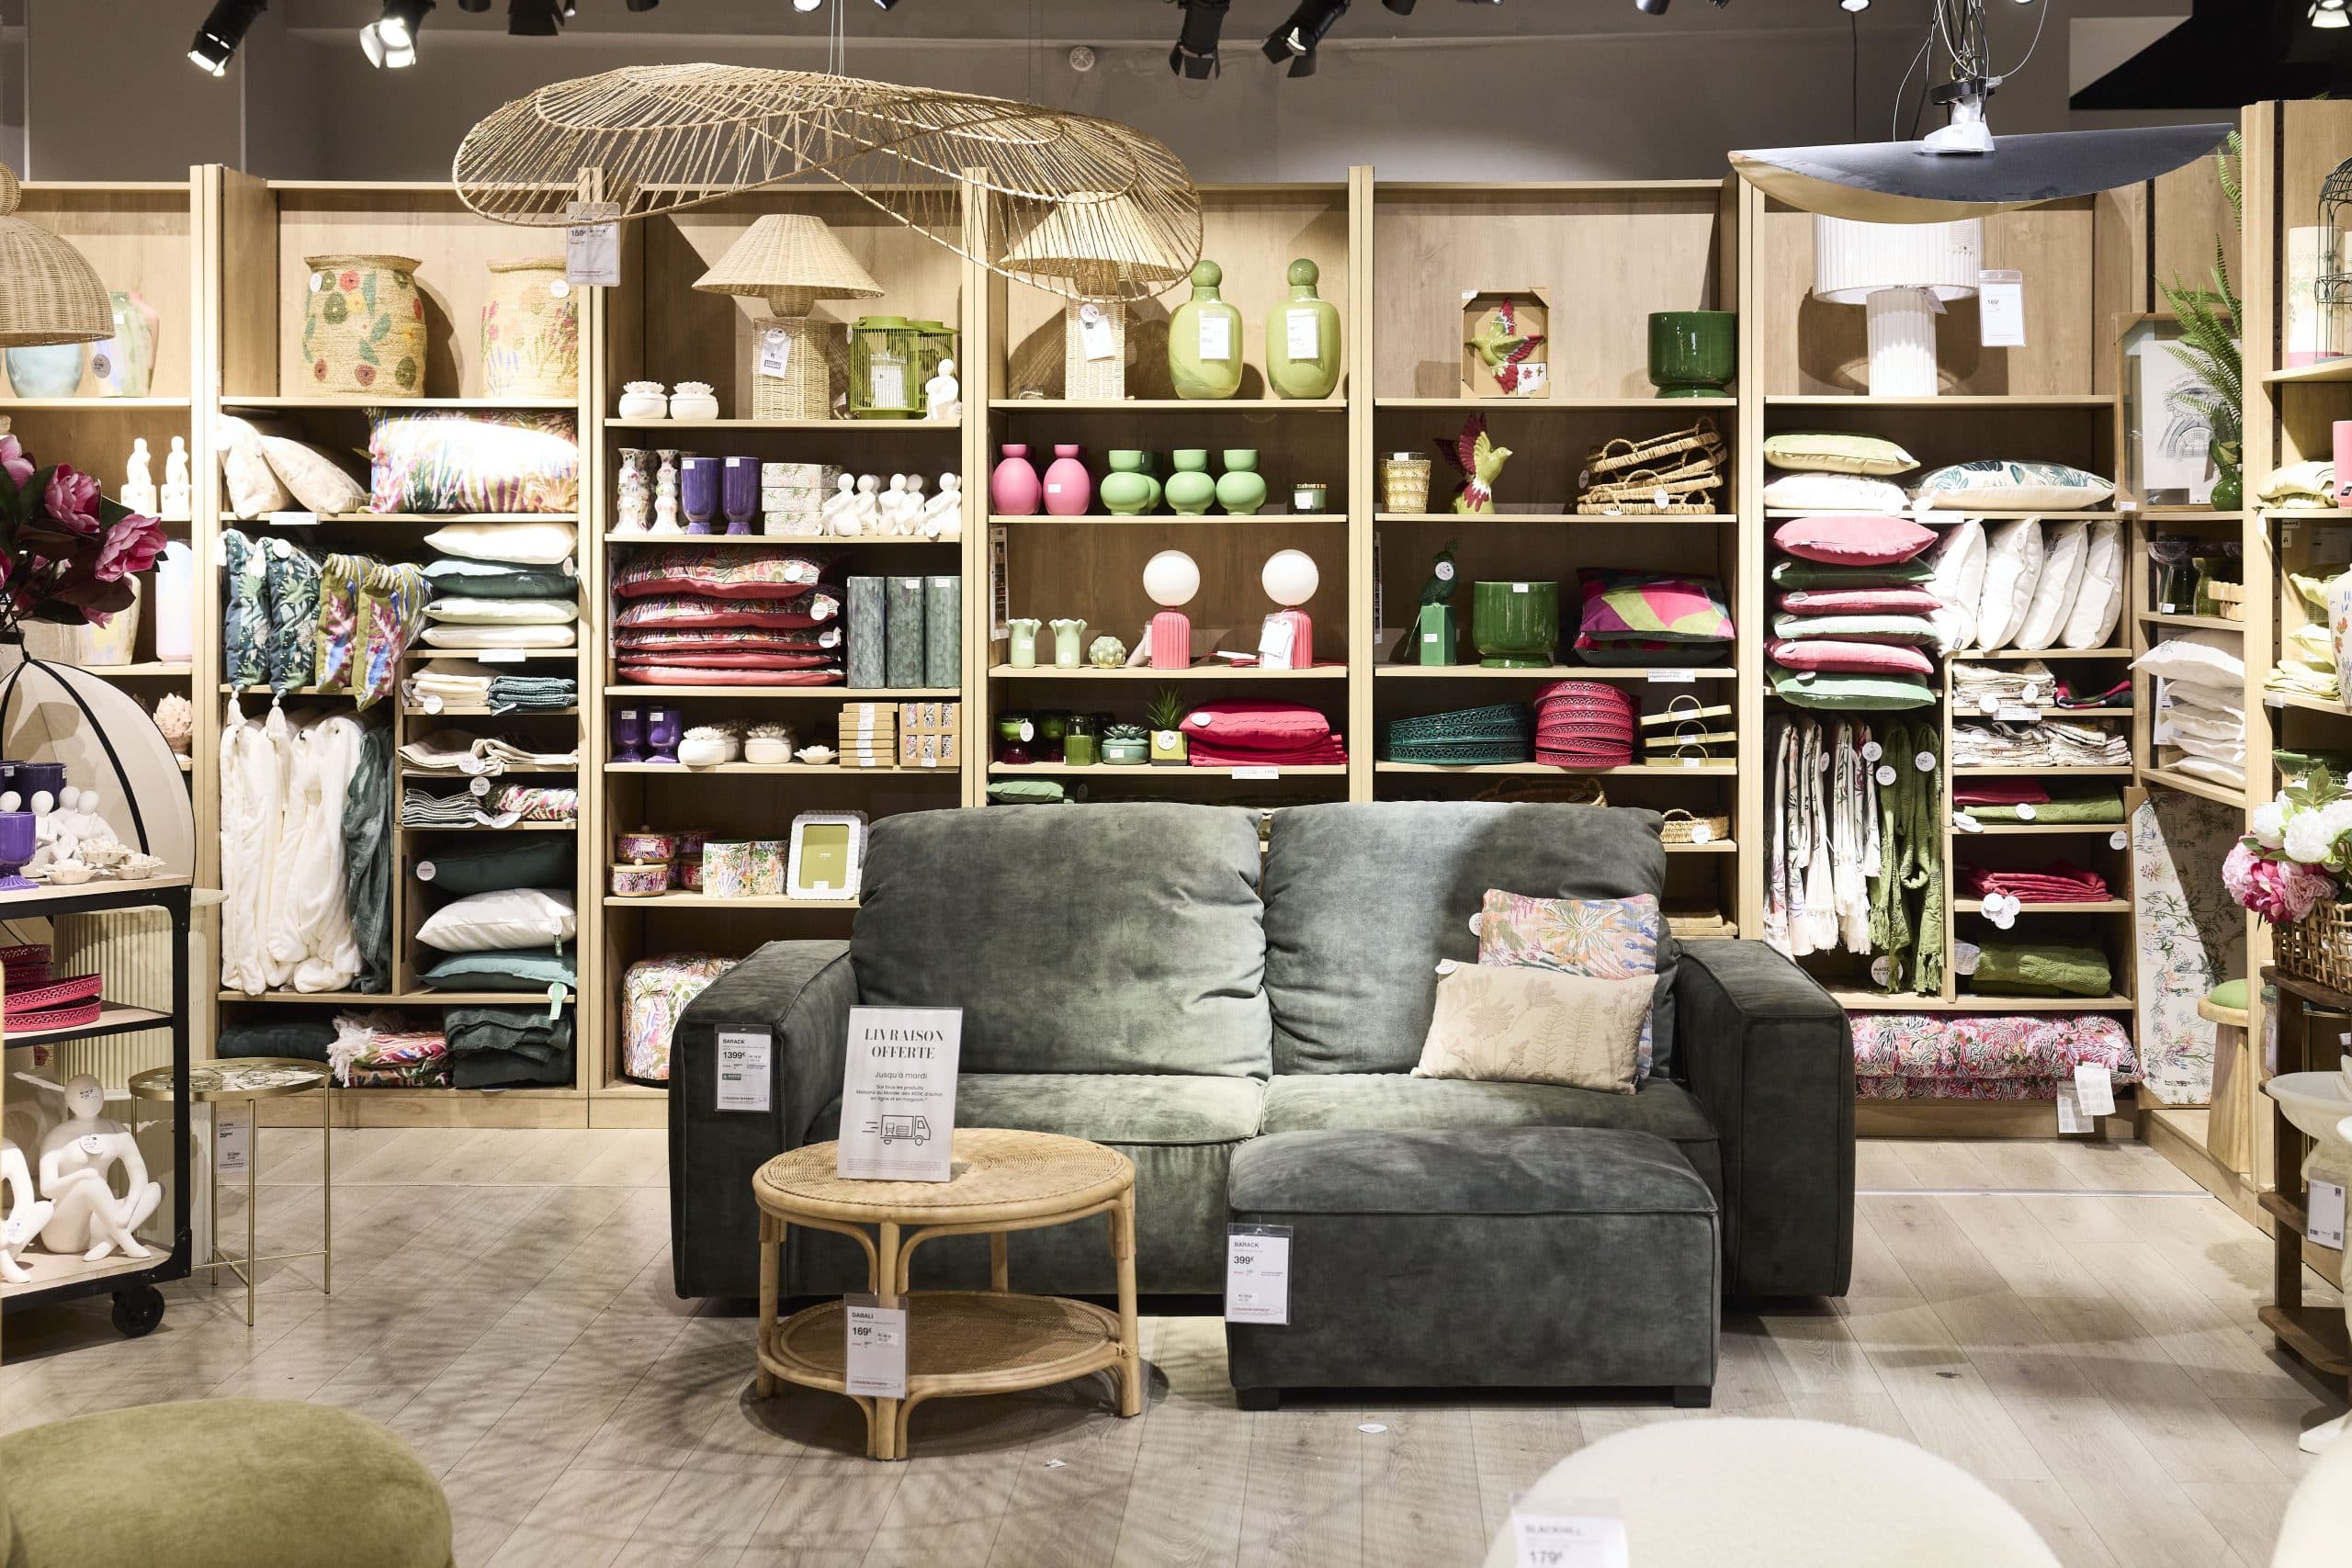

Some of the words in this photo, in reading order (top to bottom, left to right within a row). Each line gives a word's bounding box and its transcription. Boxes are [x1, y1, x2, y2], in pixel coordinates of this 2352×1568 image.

[865, 1028, 944, 1042] LIVRAISON
[723, 1051, 746, 1059] 1399€
[871, 1045, 935, 1059] OFFERTE
[875, 1071, 904, 1079] Jusqu'à
[1234, 1256, 1255, 1265] 399€
[853, 1326, 872, 1336] 169€
